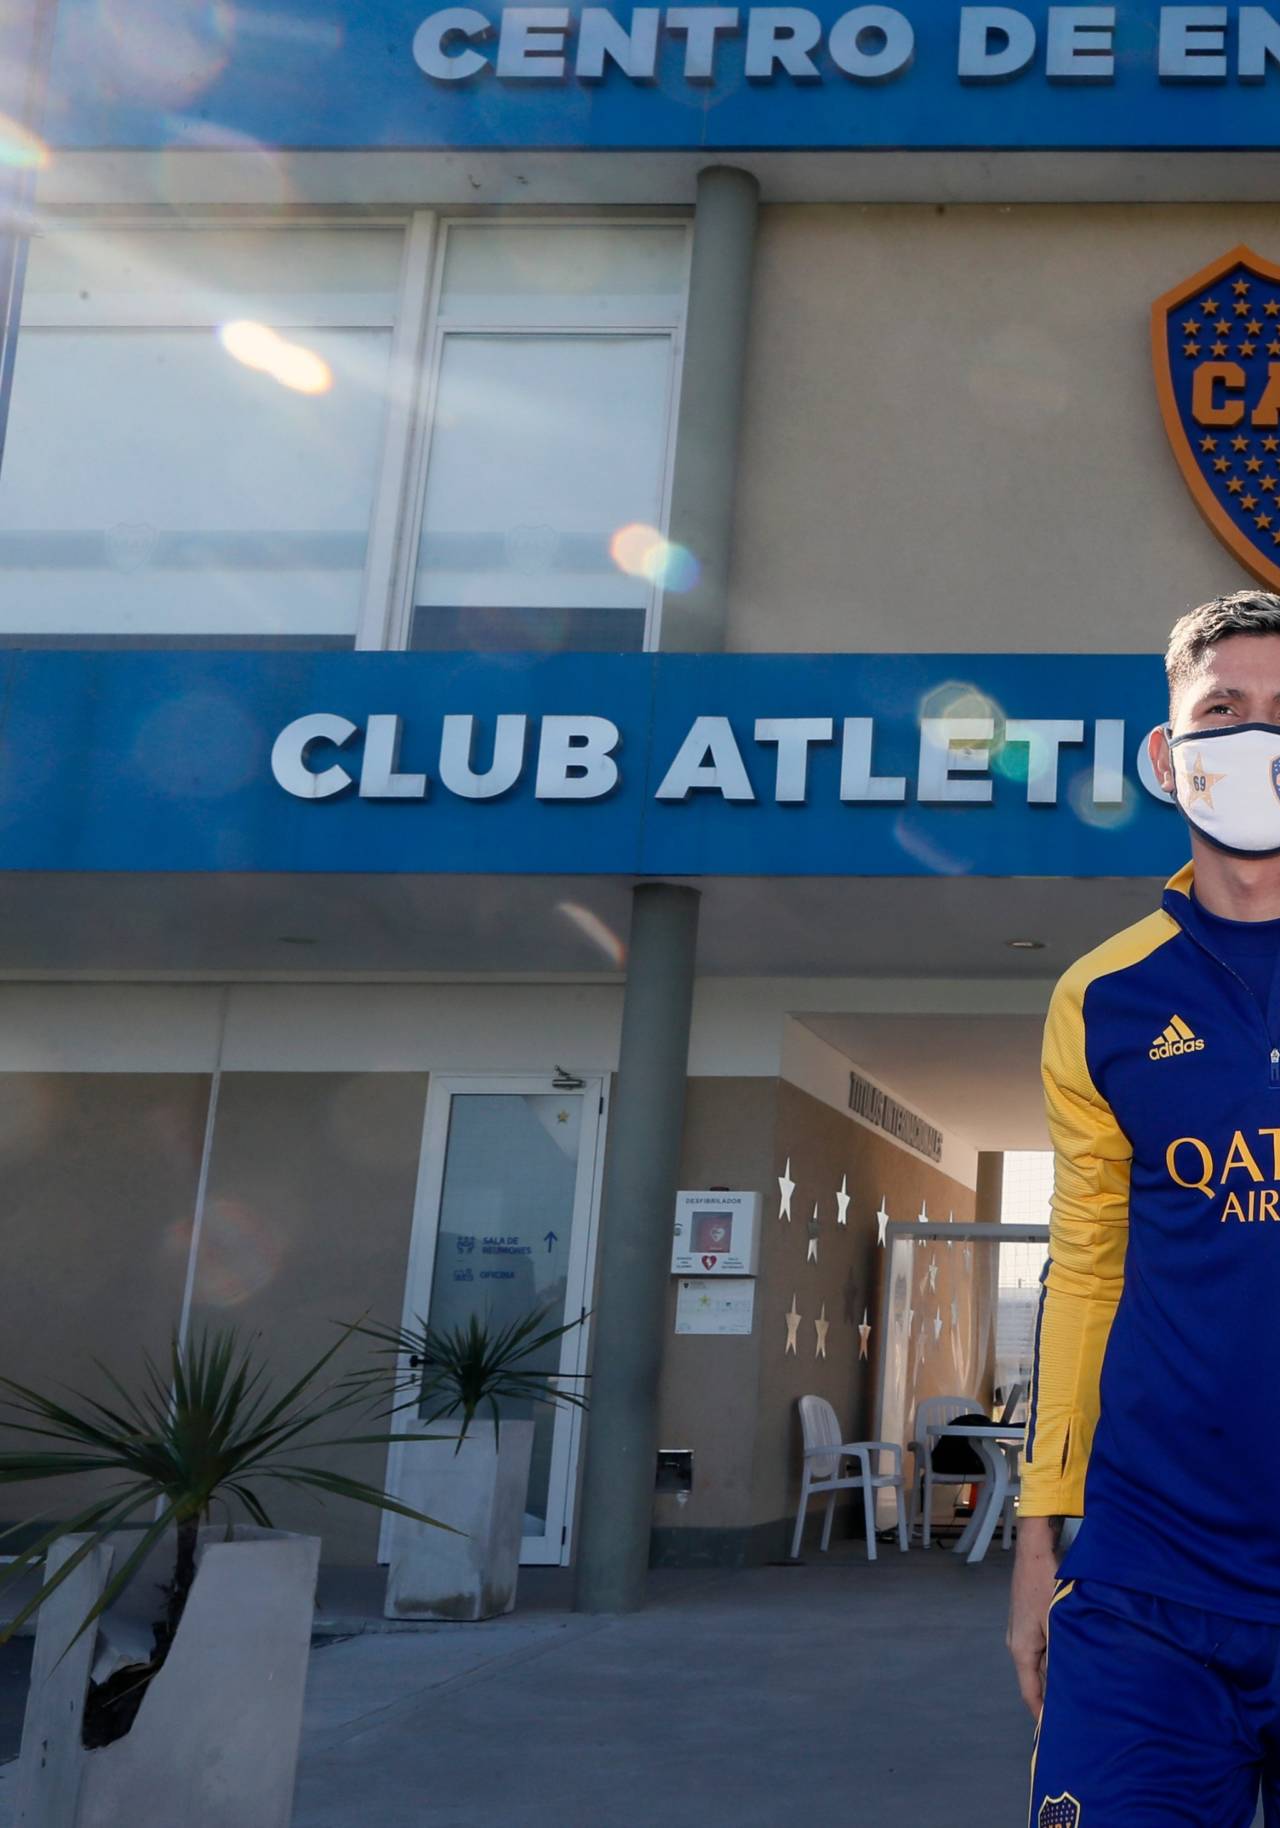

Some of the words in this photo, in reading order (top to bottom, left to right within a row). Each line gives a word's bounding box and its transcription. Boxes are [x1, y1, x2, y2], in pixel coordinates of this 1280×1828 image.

[412, 4, 916, 81] CENTRO
[958, 5, 1117, 83] DE
[270, 711, 621, 801] CLUB
[654, 716, 1176, 805] ATLETI
[1192, 775, 1207, 792] 69
[1148, 1037, 1205, 1061] adidas
